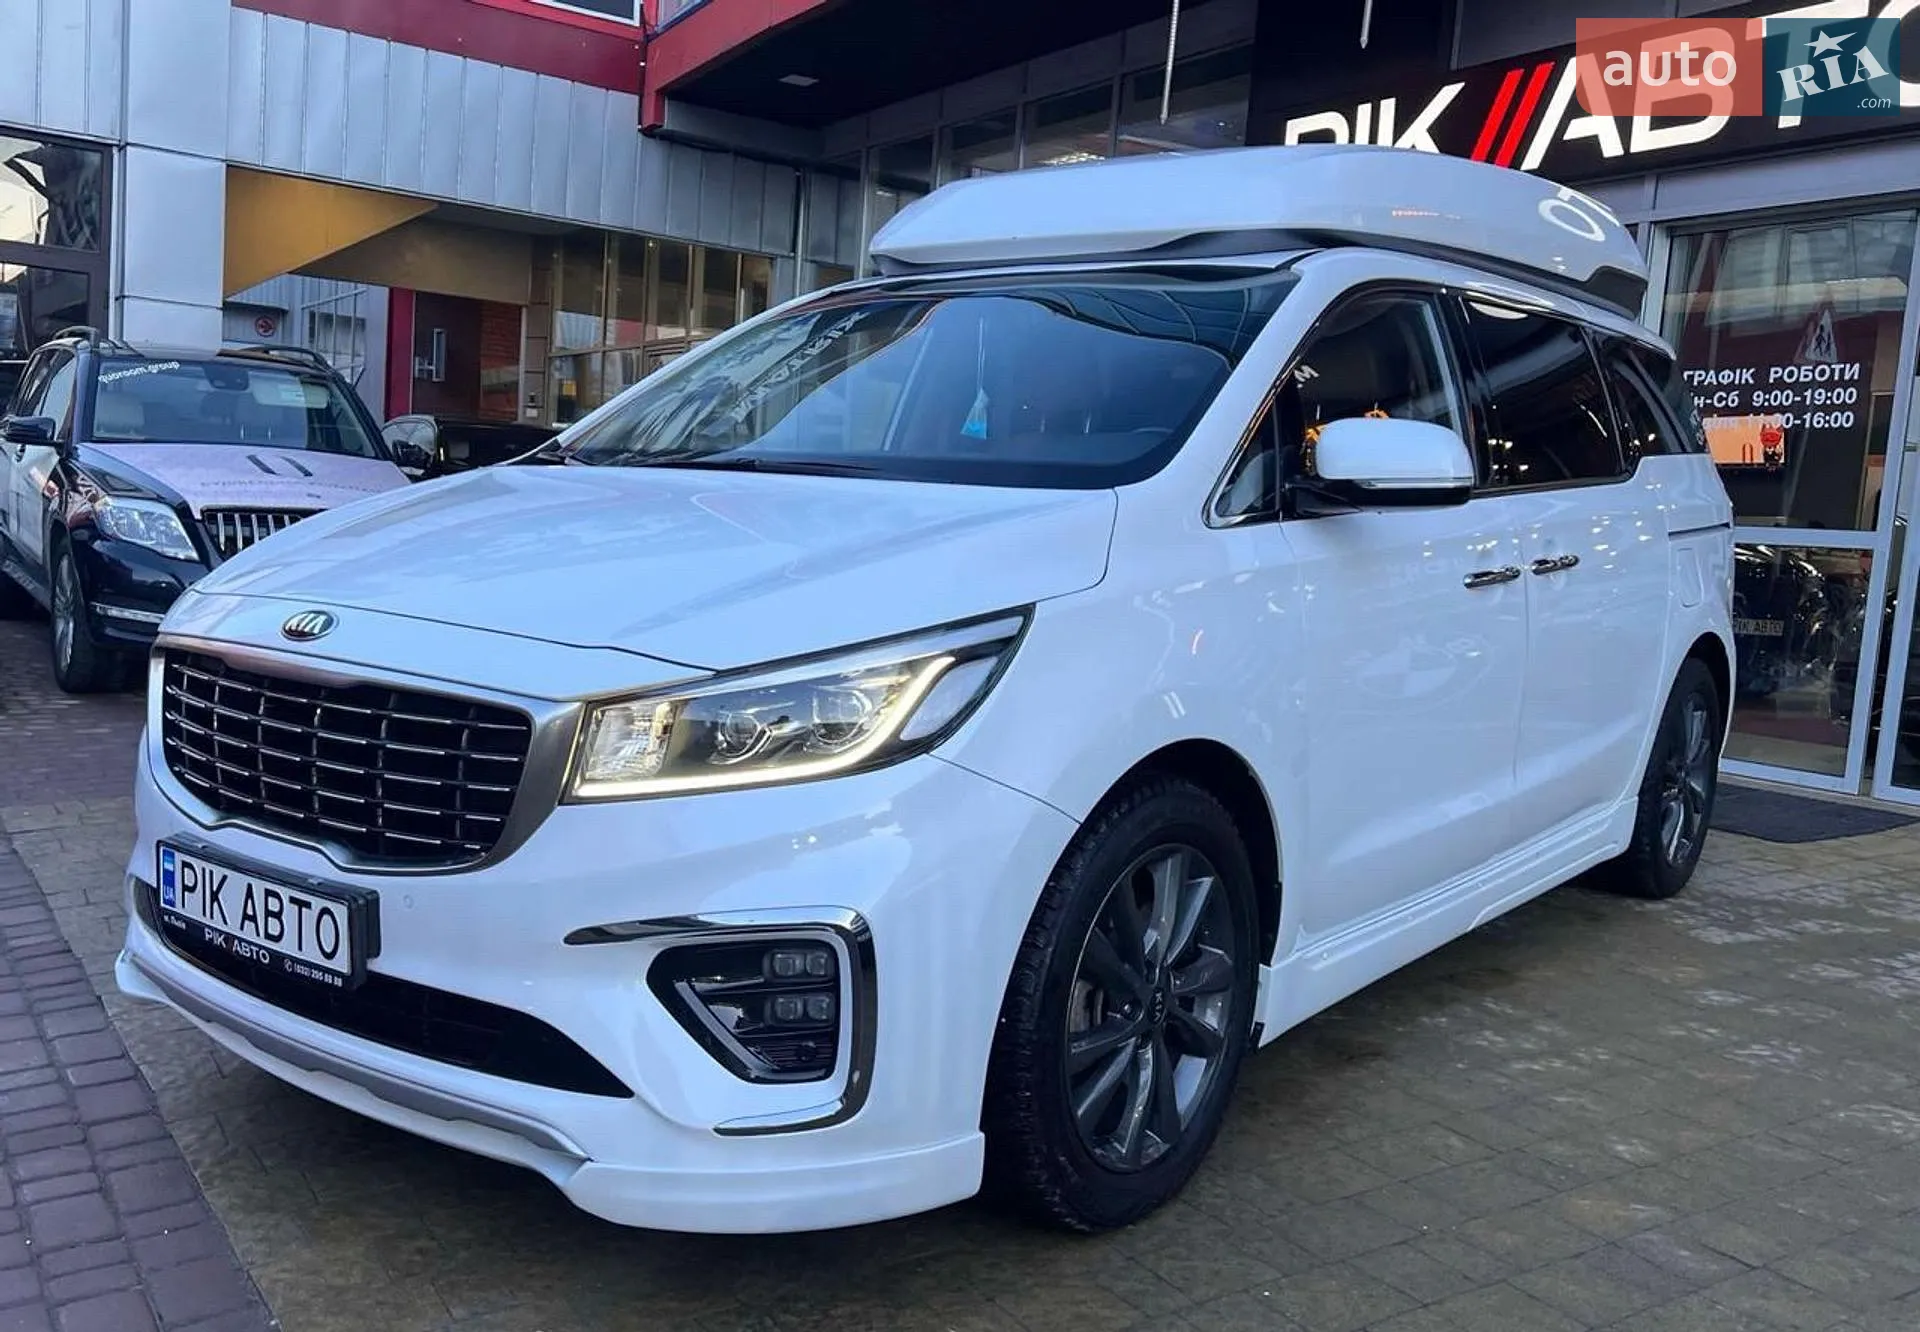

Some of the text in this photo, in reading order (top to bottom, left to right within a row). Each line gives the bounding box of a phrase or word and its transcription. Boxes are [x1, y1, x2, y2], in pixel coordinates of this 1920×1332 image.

[1683, 363, 1861, 386] ГРАФІК РОБОТИ
[1691, 387, 1858, 408] н-Сб 9:00-19:00
[285, 612, 327, 634] KIA
[181, 860, 340, 960] РІК АВТО
[204, 928, 270, 965] РІК АВТО
